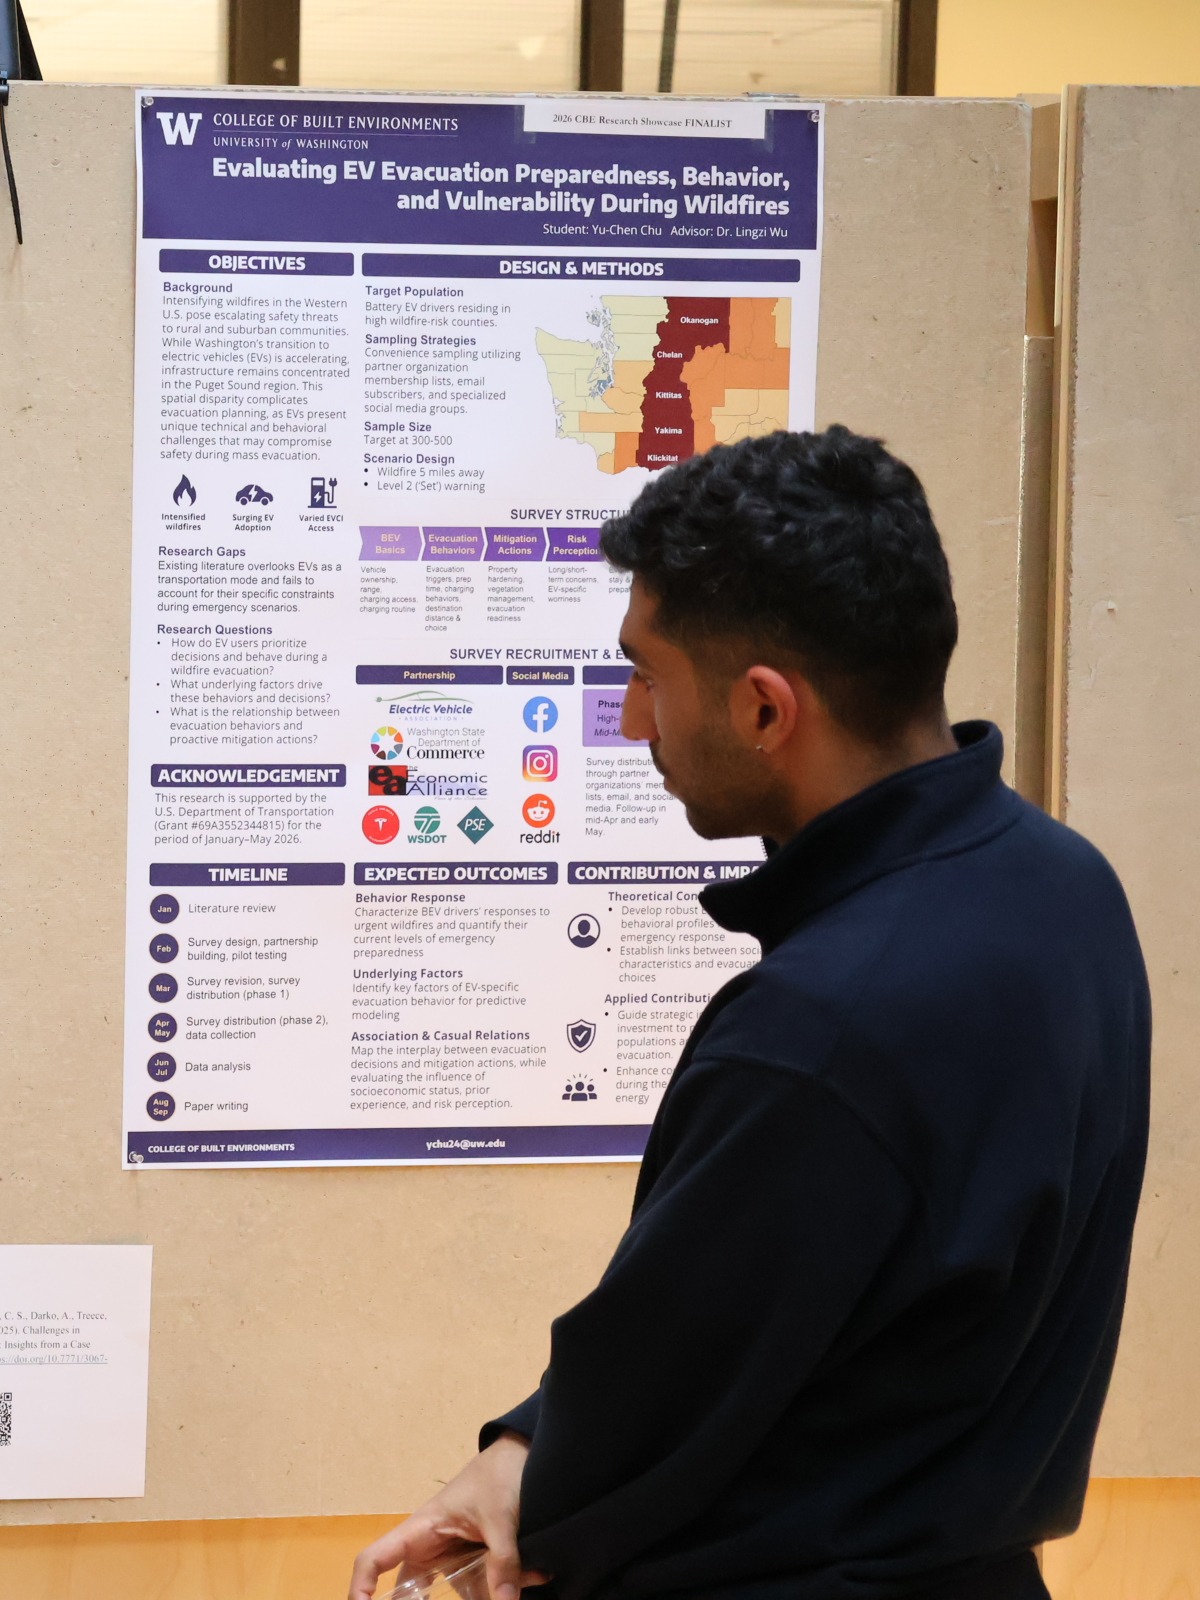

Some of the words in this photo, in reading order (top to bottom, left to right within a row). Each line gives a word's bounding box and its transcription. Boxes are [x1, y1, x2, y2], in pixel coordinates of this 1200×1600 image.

[213, 112, 274, 126] COLLEGE
[279, 114, 298, 127] OF
[303, 115, 343, 128] BUILT
[348, 116, 458, 130] ENVIRONMENTS
[553, 113, 572, 122] 2026
[574, 114, 595, 123] CBE
[599, 115, 638, 125] Research
[640, 117, 682, 126] Showcase
[685, 118, 731, 128] FINALIST
[156, 111, 202, 145] W
[212, 156, 337, 184] Evaluating
[343, 160, 375, 180] EV
[381, 161, 508, 182] Evacuation
[515, 163, 676, 189] Preparedness,
[682, 165, 789, 191] Behavior,
[396, 188, 439, 209] and
[445, 189, 595, 217] Vulnerability
[601, 192, 677, 218] During
[683, 193, 789, 215] Wildfires
[208, 255, 306, 272] OBJECTIVES
[499, 260, 560, 274] DESIGN
[565, 261, 578, 274] &
[582, 260, 663, 276] METHODS
[680, 316, 719, 325] Okanogan
[655, 350, 684, 359] Chelan
[655, 391, 682, 399] Kittitas
[654, 426, 682, 434] Yakima
[647, 454, 678, 462] Klickitat
[403, 670, 455, 681] Partnership
[512, 671, 540, 680] Social
[542, 671, 569, 680] Media
[157, 768, 340, 784] ACKNOWLEDGEMENT
[464, 818, 487, 831] PSE
[407, 834, 447, 843] WSDOT
[519, 829, 560, 844] reddit
[208, 868, 288, 881] TIMELINE
[364, 867, 450, 881] EXPECTED
[453, 866, 547, 880] OUTCOMES
[188, 903, 239, 913] Literature
[242, 905, 276, 913] review
[155, 943, 173, 954] Feb
[425, 1138, 505, 1150] ychu24@uw.edu
[4, 1340, 37, 1351] Insights
[40, 1339, 60, 1348] from
[69, 1340, 91, 1348] Case
